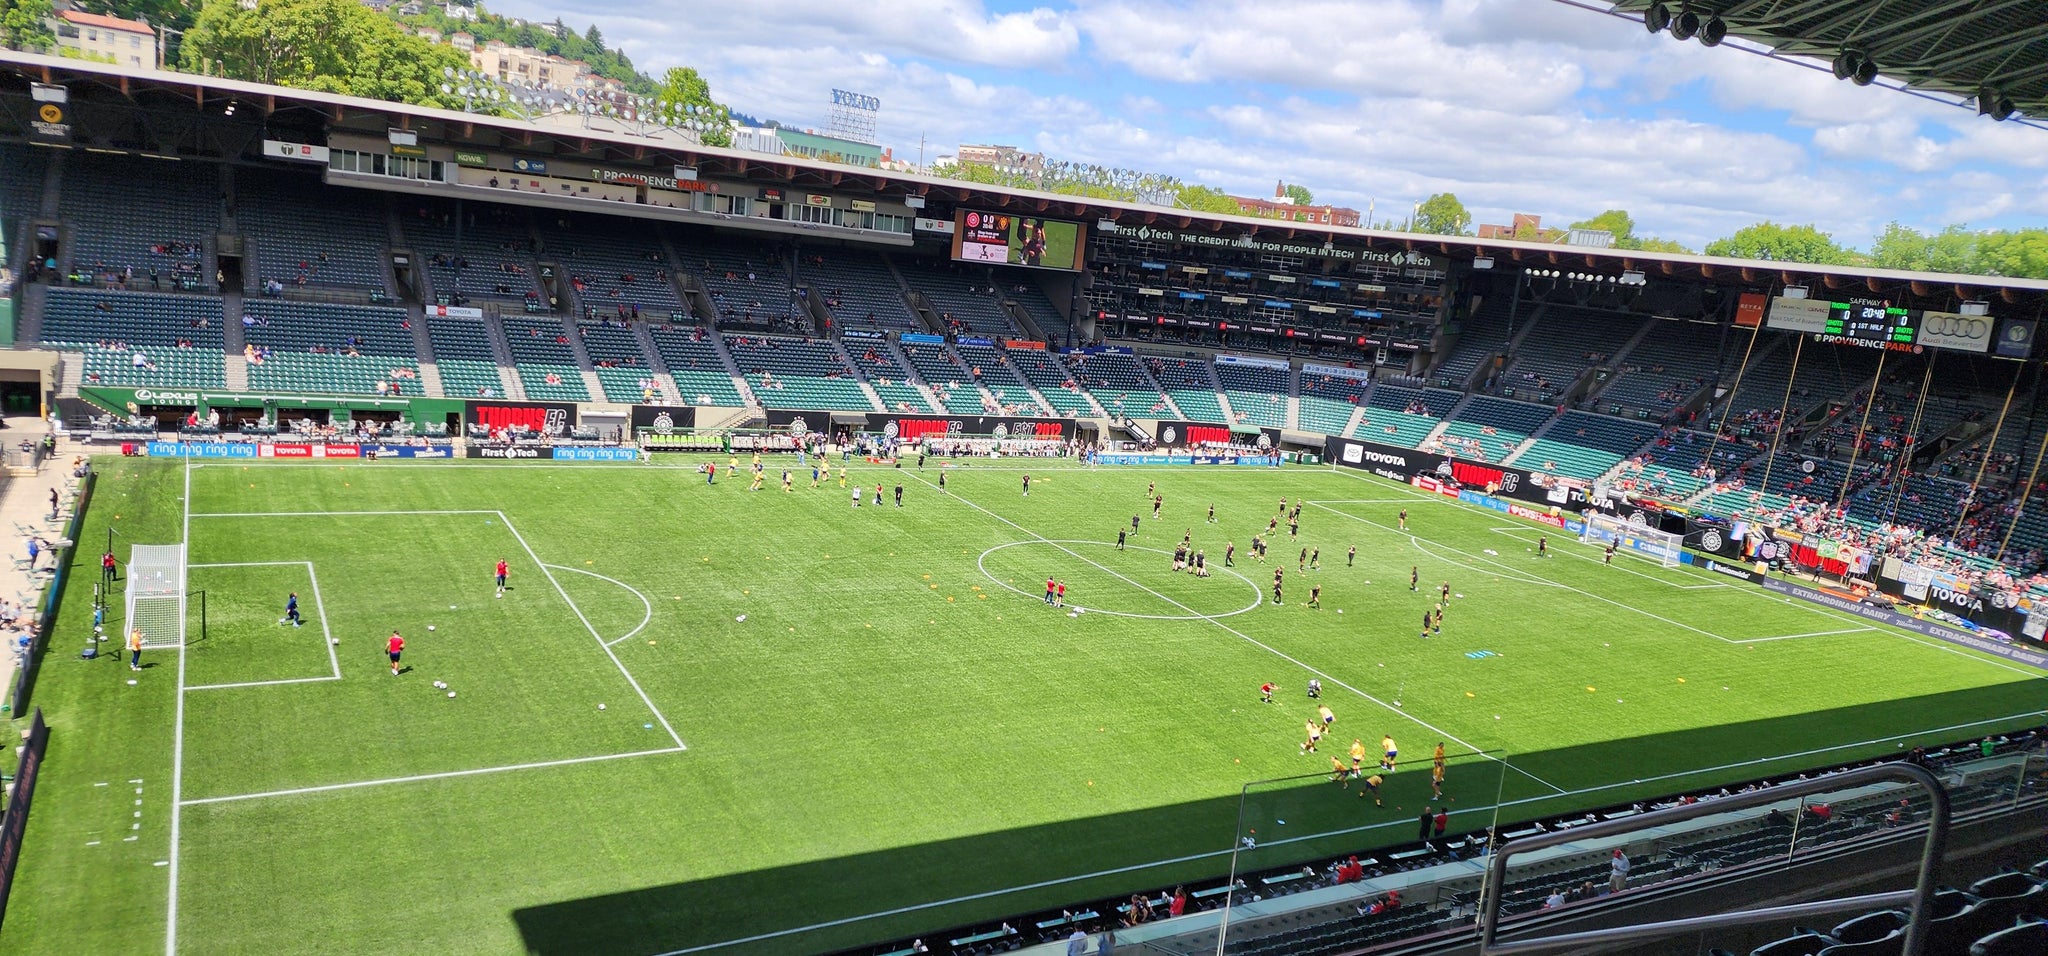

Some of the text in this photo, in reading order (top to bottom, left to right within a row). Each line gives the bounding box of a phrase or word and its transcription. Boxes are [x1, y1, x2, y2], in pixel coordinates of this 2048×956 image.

[832, 88, 880, 111] VOLVO
[983, 214, 995, 223] 0 0
[1114, 225, 1137, 236] First
[1150, 229, 1173, 240] Tech
[1180, 234, 1197, 243] THE
[1198, 236, 1230, 247] CREDIT
[1231, 239, 1260, 250] UNION
[1262, 242, 1281, 252] FOR
[1282, 244, 1317, 255] PEOPLE
[1318, 249, 1328, 257] IN
[1329, 249, 1355, 260] TECH
[1362, 251, 1390, 263] First
[1849, 297, 1881, 306] SAFEWAY
[1844, 311, 1908, 326] 0 0
[1862, 307, 1885, 319] 20:48
[1886, 307, 1908, 315] ROYALS
[1827, 319, 1844, 327] SHOTS
[1857, 322, 1868, 330] 1ST
[1870, 323, 1885, 331] HALF
[151, 390, 198, 400] LEXUS
[476, 406, 567, 432] THORNS FC
[899, 419, 963, 441] THORNS FC
[1012, 422, 1062, 440] EST 2012
[1186, 426, 1231, 443] THORNS
[154, 443, 177, 456] ring
[206, 444, 228, 457] ring
[231, 445, 253, 457] ring
[481, 449, 538, 458] First Tech
[557, 449, 633, 461] ring ring ring ring
[1104, 456, 1115, 465] ring
[1129, 456, 1140, 464] ring
[1364, 451, 1406, 467] TOYOTA
[1376, 468, 1388, 478] First
[1452, 462, 1520, 493] THORNS FC
[1471, 494, 1482, 504] ring
[1486, 498, 1498, 508] ring
[1498, 501, 1509, 511] ring
[1792, 587, 1863, 613] EXTRAORDINARY
[1863, 607, 1891, 621] DAIRY
[1895, 619, 2046, 665] Tillamook EXTRAORDINARY DAIRY
